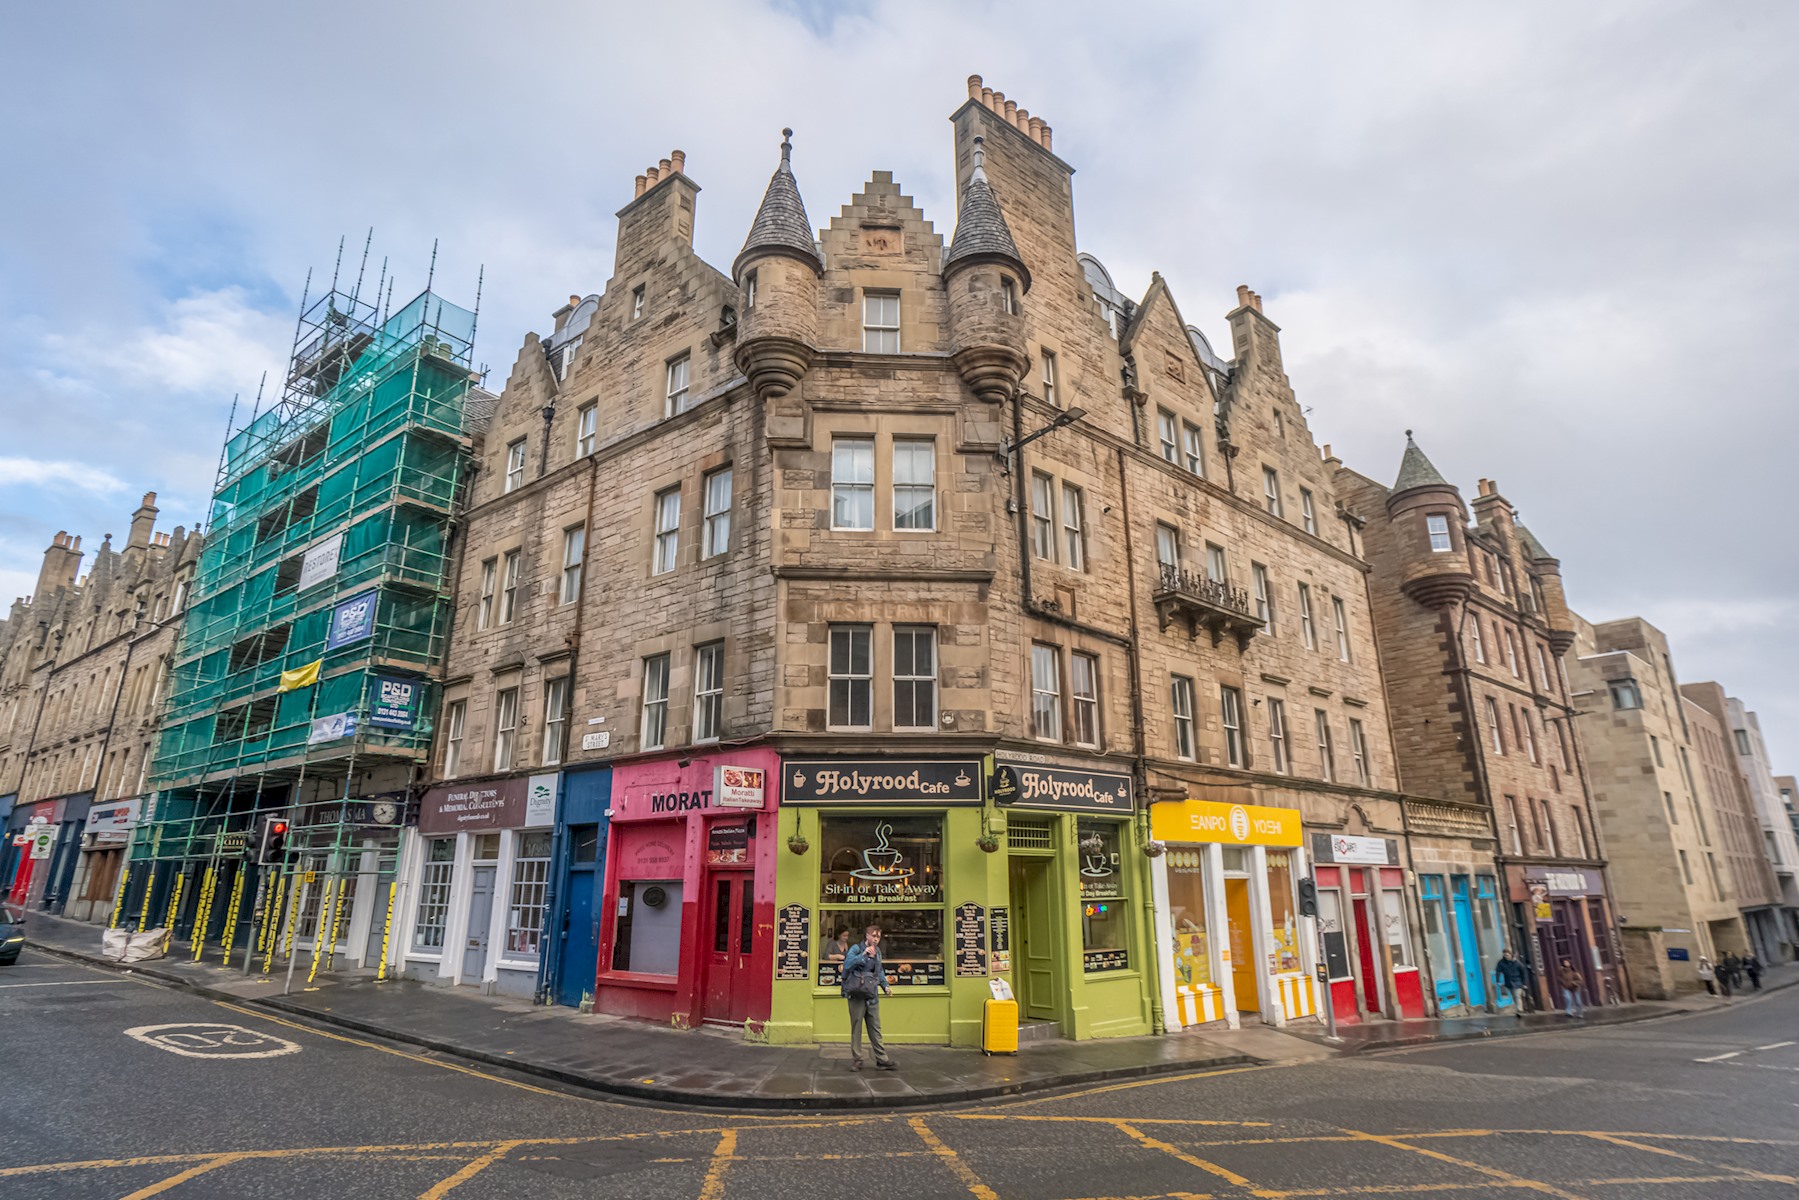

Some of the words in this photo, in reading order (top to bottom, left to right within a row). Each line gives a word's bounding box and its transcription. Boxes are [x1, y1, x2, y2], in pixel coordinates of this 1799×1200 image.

[342, 602, 367, 621] P&D
[382, 681, 412, 697] P&D
[587, 740, 604, 748] STREET
[996, 750, 1028, 761] HOLYROOD
[1029, 755, 1045, 763] ROAD
[815, 770, 920, 795] Holyrood
[919, 782, 950, 794] Cafe
[1022, 772, 1094, 801] Holyrood
[1093, 791, 1114, 804] Cafe
[731, 788, 755, 797] Moratti
[994, 787, 1016, 795] HOLYROOD
[530, 798, 552, 808] Dignity
[1190, 814, 1227, 832] SANPO
[1253, 819, 1282, 835] YOSHI
[825, 883, 854, 895] Sit-in
[857, 885, 870, 894] or
[860, 895, 876, 904] Day
[878, 894, 917, 902] Breakfast
